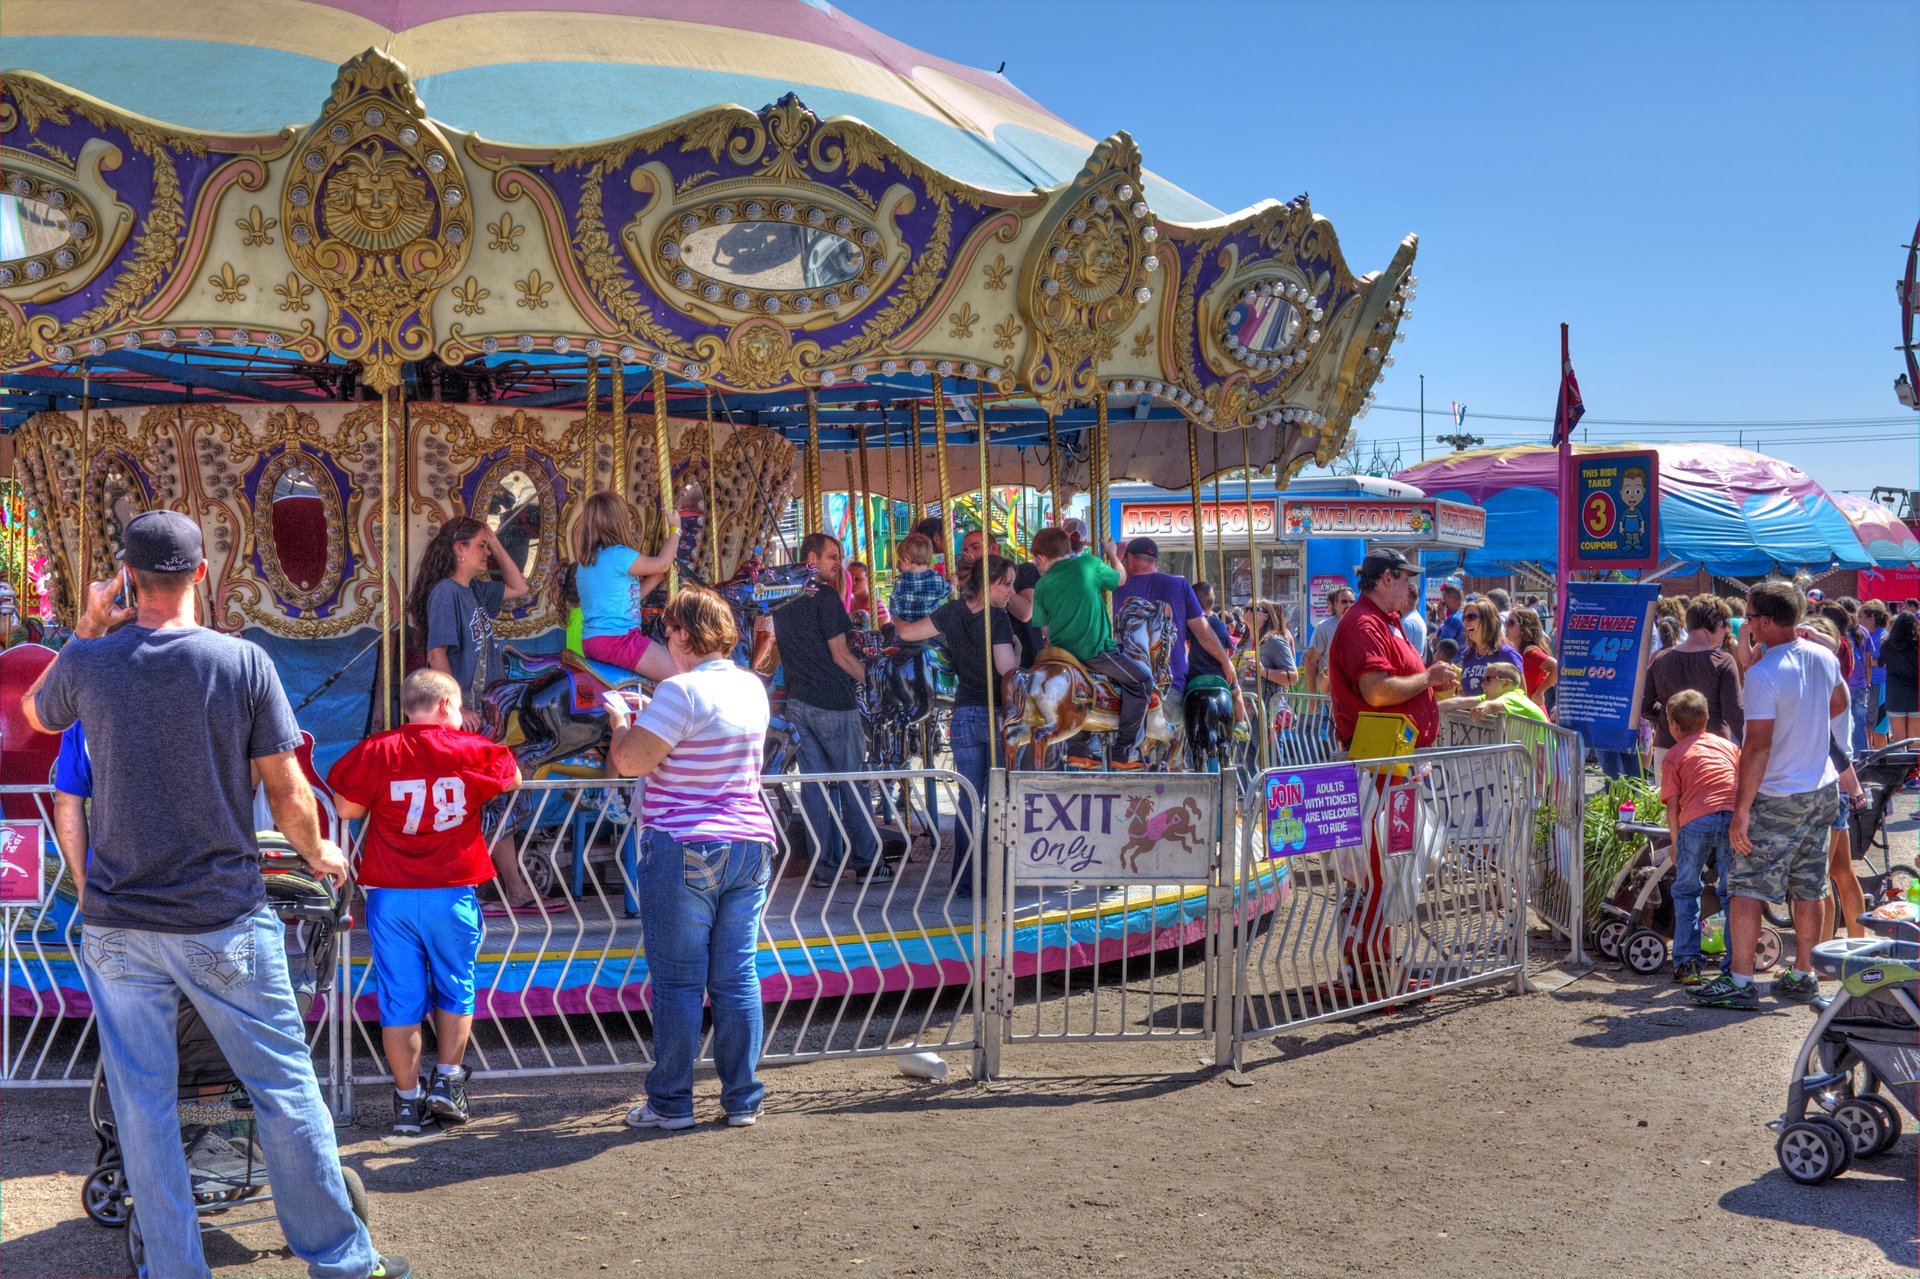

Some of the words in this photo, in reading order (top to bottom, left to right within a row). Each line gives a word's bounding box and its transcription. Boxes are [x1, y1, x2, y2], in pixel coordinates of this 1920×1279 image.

[1582, 469, 1599, 478] THIS
[1600, 468, 1617, 477] RIDE
[1588, 479, 1611, 488] TAKES
[1128, 510, 1172, 534] RIDE
[1312, 506, 1413, 532] WELCOME
[1590, 499, 1607, 531] 3
[1580, 541, 1618, 550] COUPONS
[1568, 614, 1599, 630] SIZE
[1598, 615, 1637, 632] WIZE
[1449, 721, 1496, 746] EXIT
[1268, 783, 1302, 810] JOIN
[1315, 781, 1345, 794] ADULTS
[390, 776, 468, 835] 78
[1024, 793, 1121, 834] EXIT
[1304, 797, 1325, 810] WITH
[1326, 793, 1357, 807] TICKETS
[1305, 811, 1321, 823] ARE
[1321, 806, 1359, 821] WELCOME
[1271, 817, 1304, 846] FUN
[1318, 824, 1329, 835] TO
[1330, 821, 1348, 834] RIDE
[1030, 835, 1102, 872] Only
